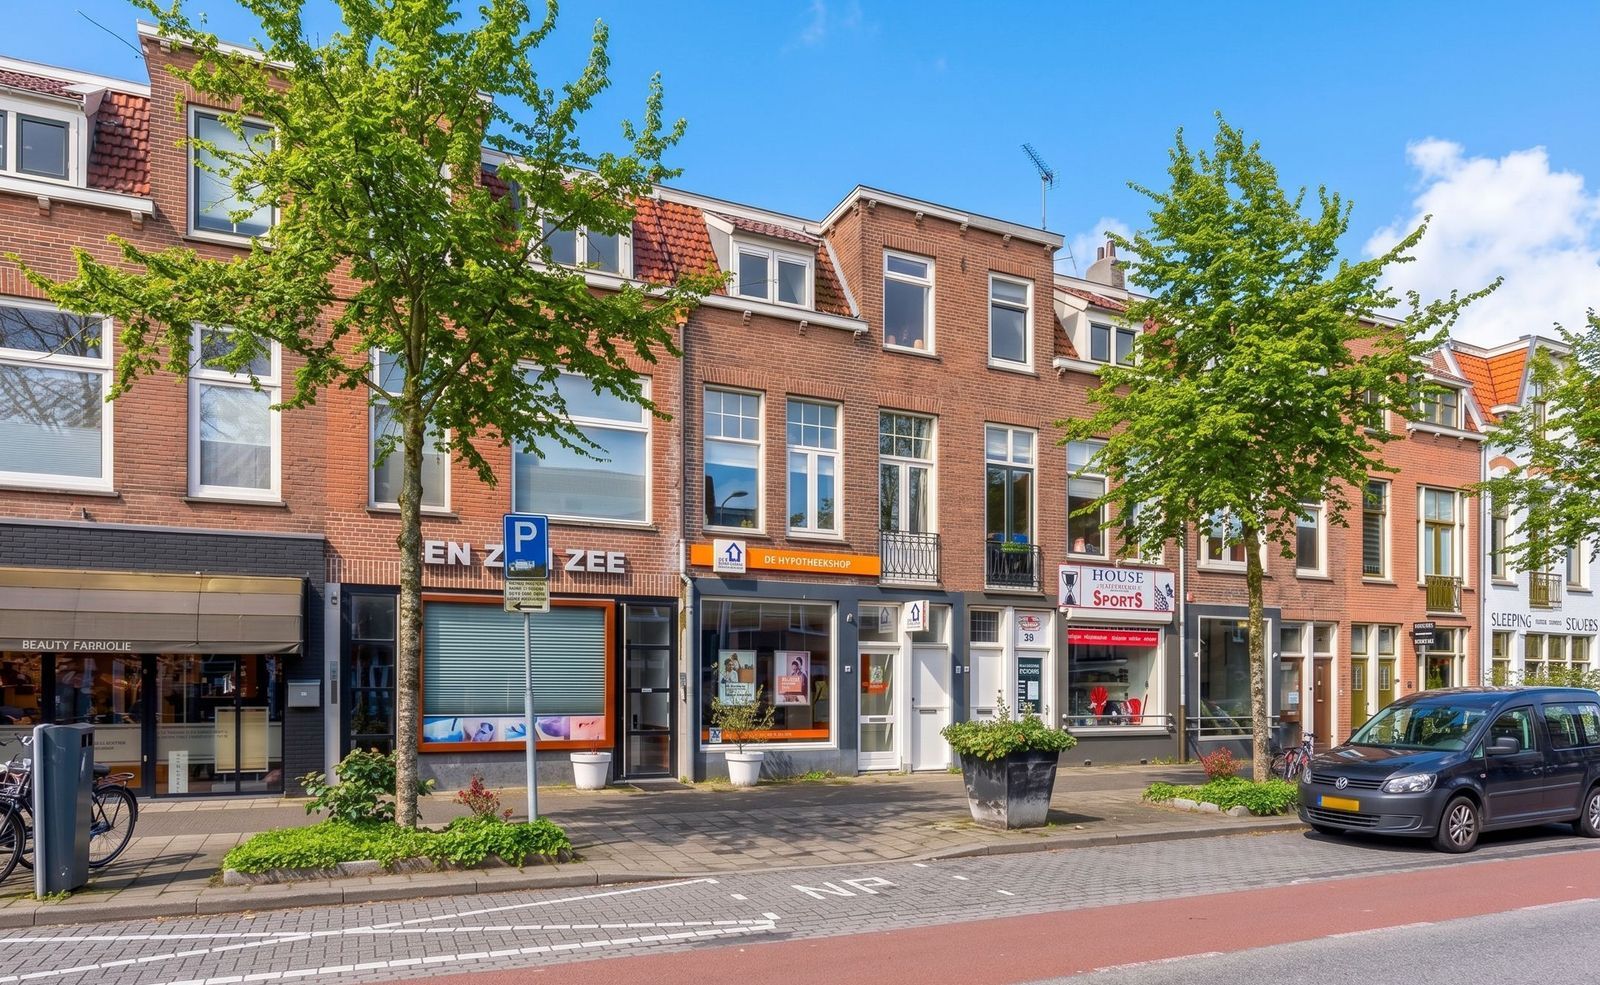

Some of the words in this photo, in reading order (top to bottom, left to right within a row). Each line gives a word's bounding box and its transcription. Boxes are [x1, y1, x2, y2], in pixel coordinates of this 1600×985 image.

[514, 521, 538, 553] P
[565, 549, 625, 574] ZEE
[764, 555, 776, 564] DE
[778, 556, 851, 569] HYPOTHEEKSHOP
[1092, 568, 1144, 584] HOUSE
[1491, 612, 1532, 628] SLEEPING
[22, 640, 69, 650] BEAUTY
